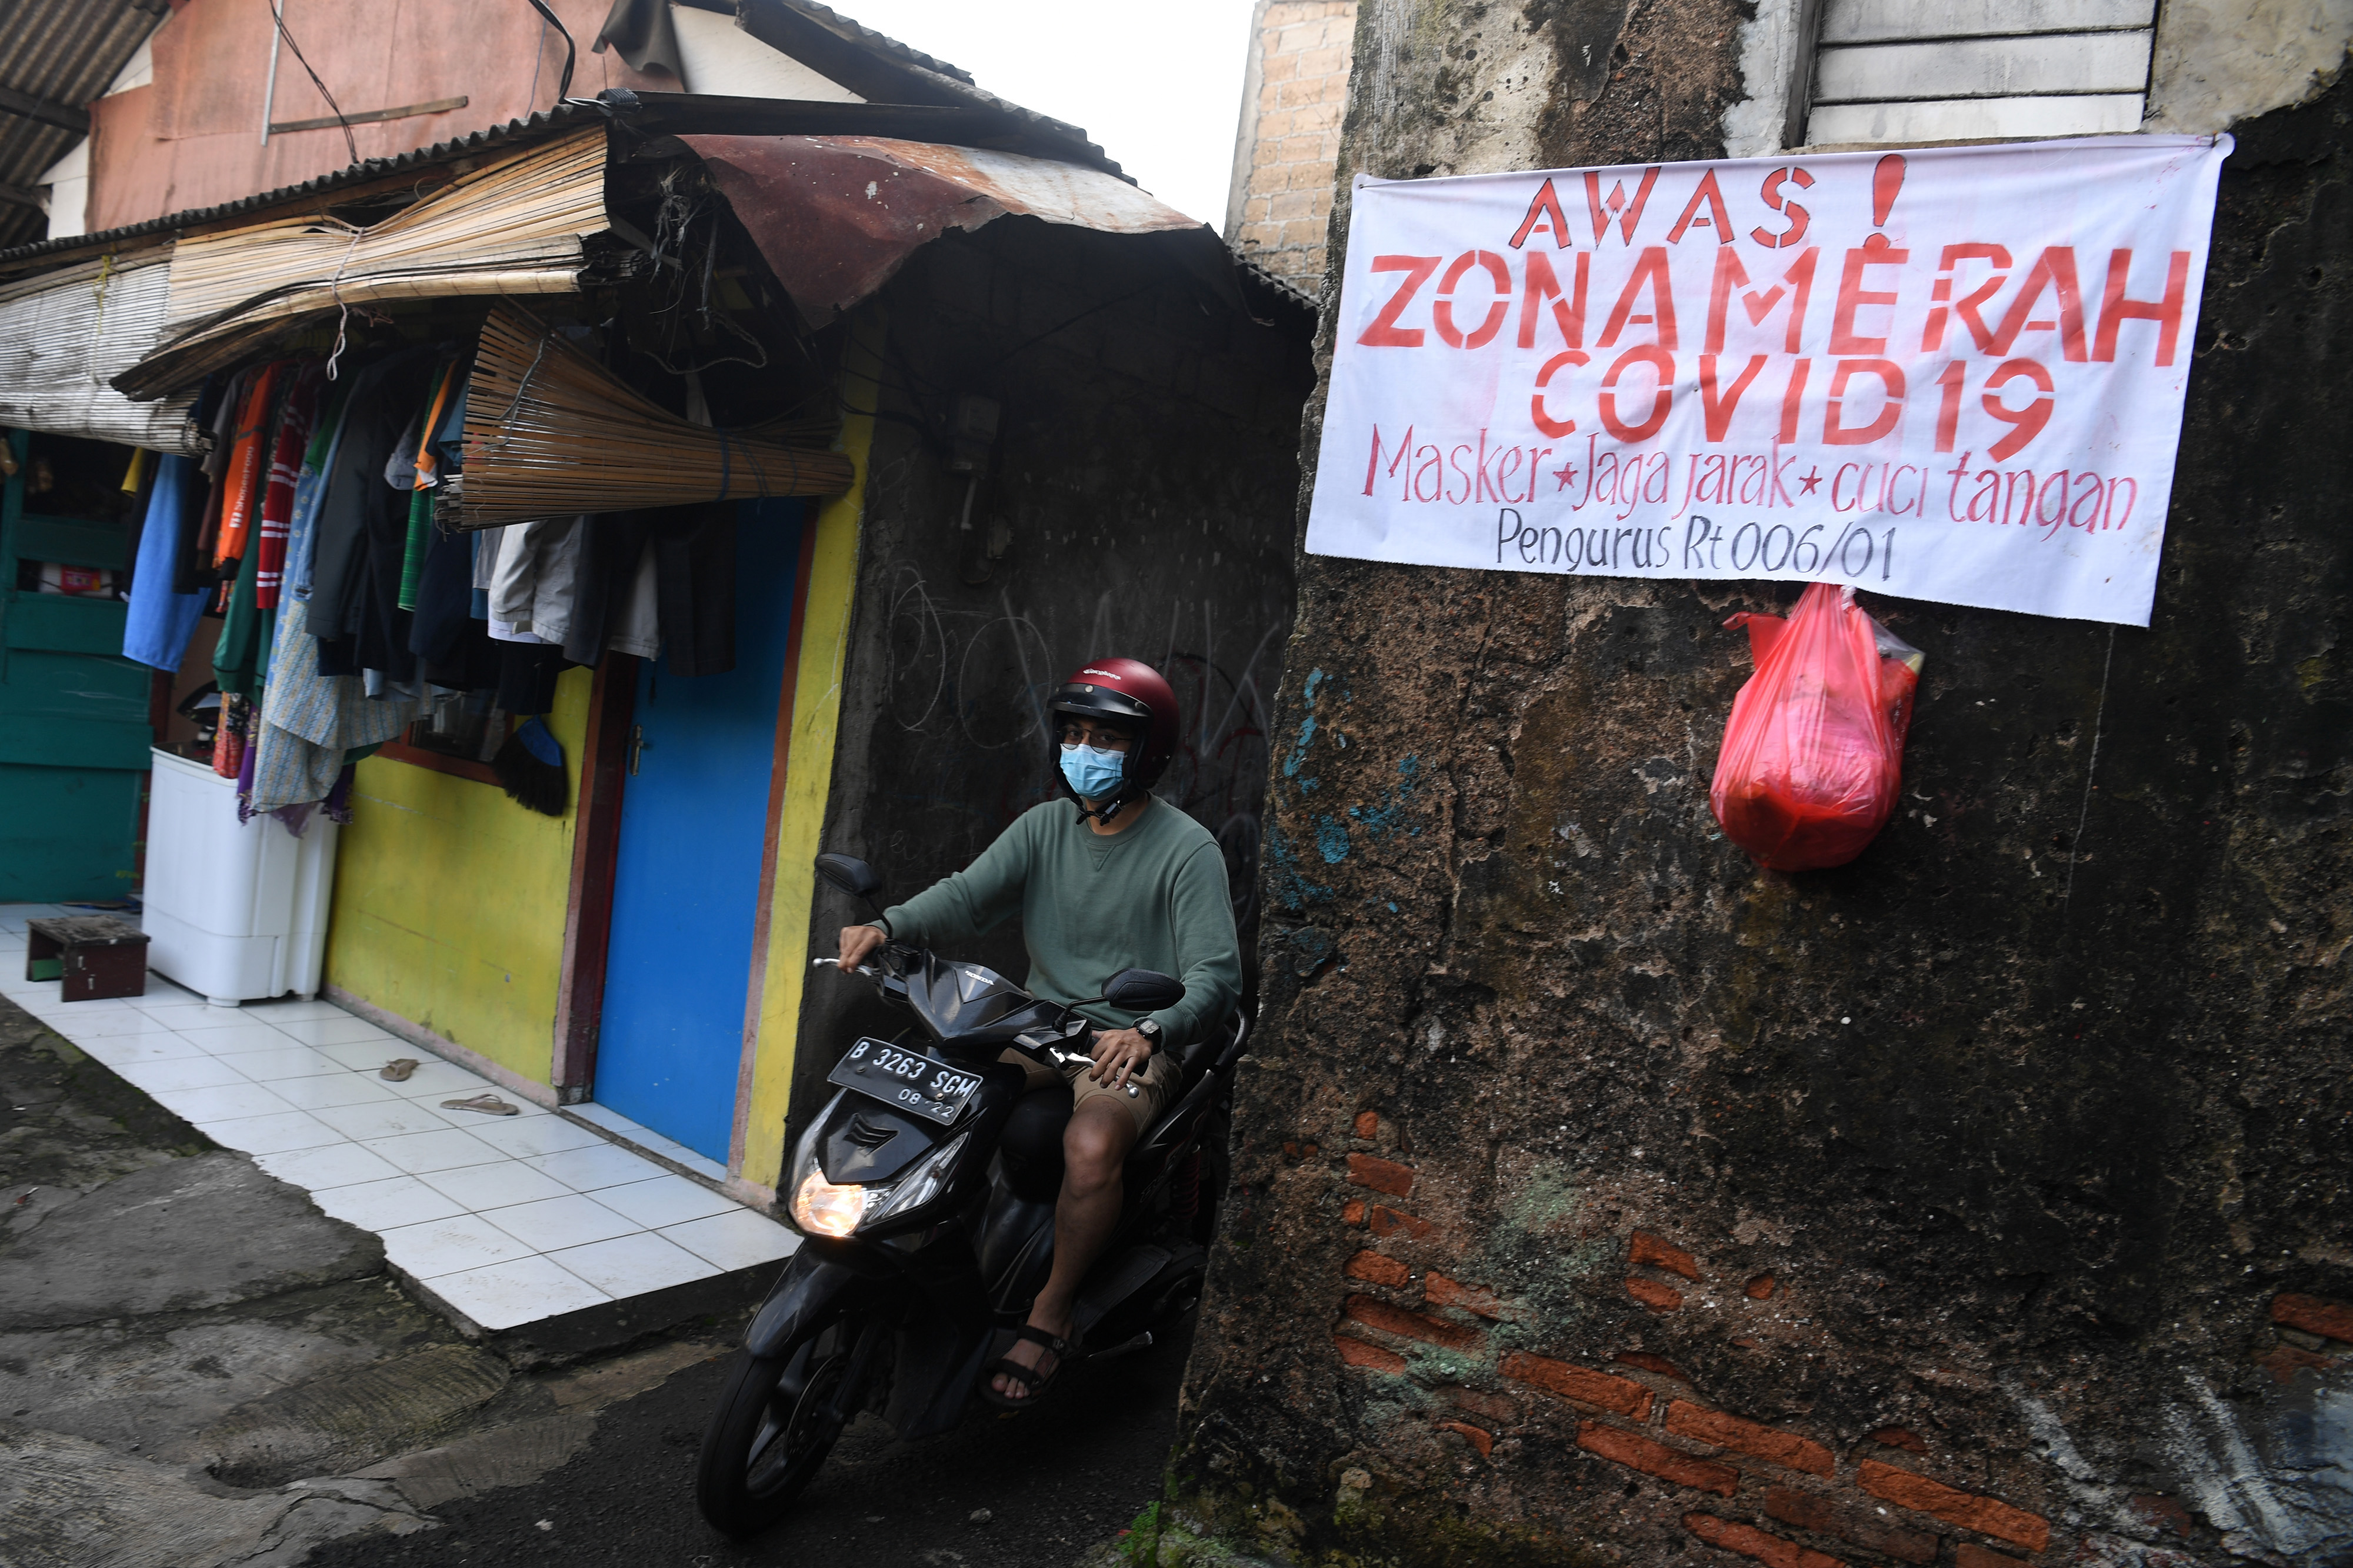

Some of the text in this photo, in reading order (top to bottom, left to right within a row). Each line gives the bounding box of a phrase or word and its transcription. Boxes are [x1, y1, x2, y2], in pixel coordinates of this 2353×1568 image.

[1509, 166, 1815, 249] AWAS
[1358, 243, 2191, 367] ZONA MERAH
[1531, 345, 2054, 463] COVID 19
[1361, 423, 1552, 505] Masker
[1572, 432, 1669, 521] Jaga
[1831, 462, 1928, 519] cuci
[1948, 451, 2138, 542] tangan
[1497, 508, 1672, 572] Pengurus
[965, 970, 994, 985] HONDA
[850, 1042, 976, 1098] B 3263 SGM
